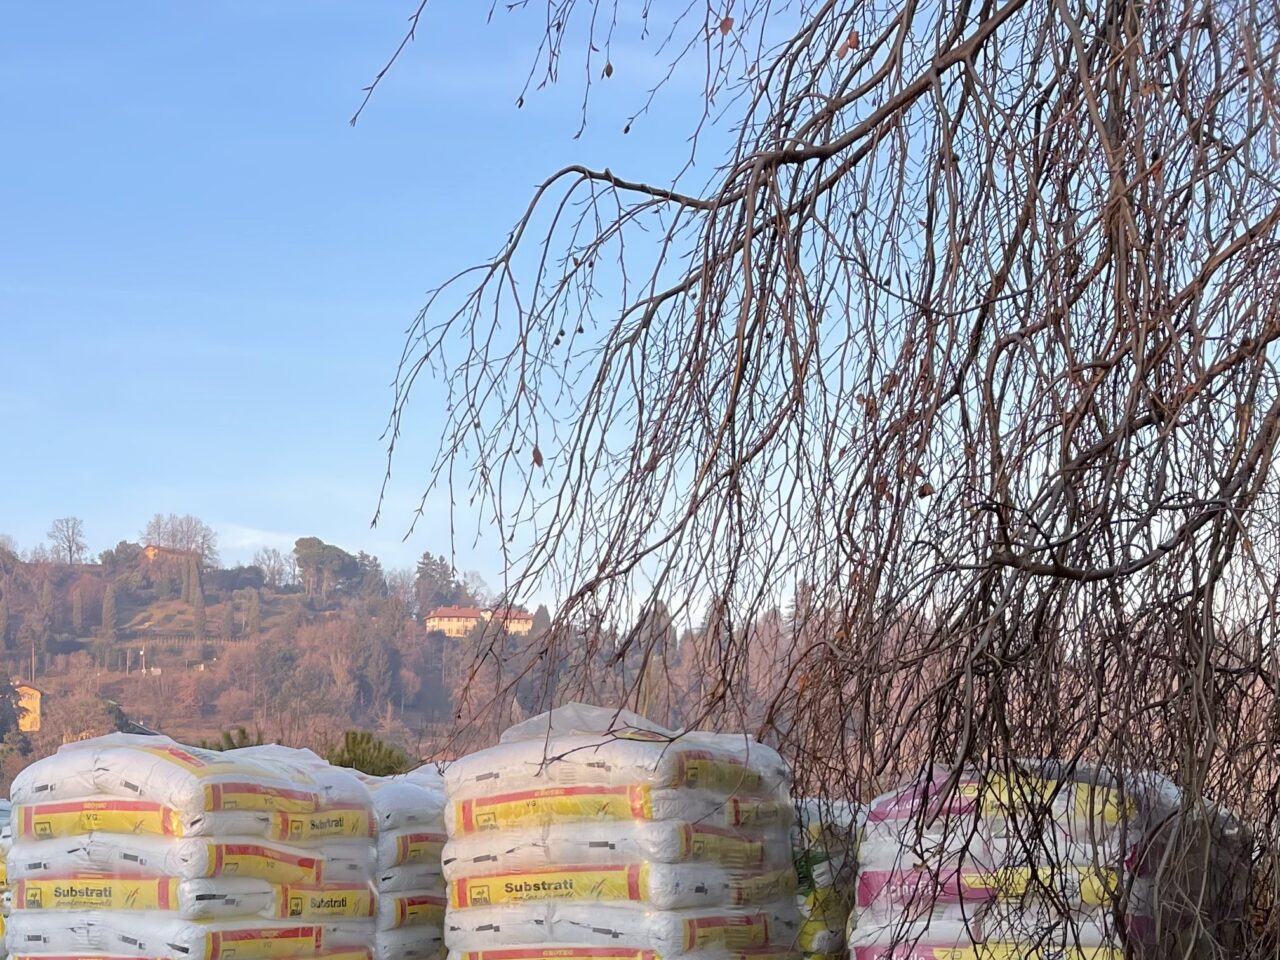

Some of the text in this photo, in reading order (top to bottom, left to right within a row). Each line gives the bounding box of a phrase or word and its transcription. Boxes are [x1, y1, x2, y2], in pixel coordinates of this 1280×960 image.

[504, 879, 574, 893] Substrati
[54, 887, 112, 898] Substrati
[310, 897, 347, 909] Substrati
